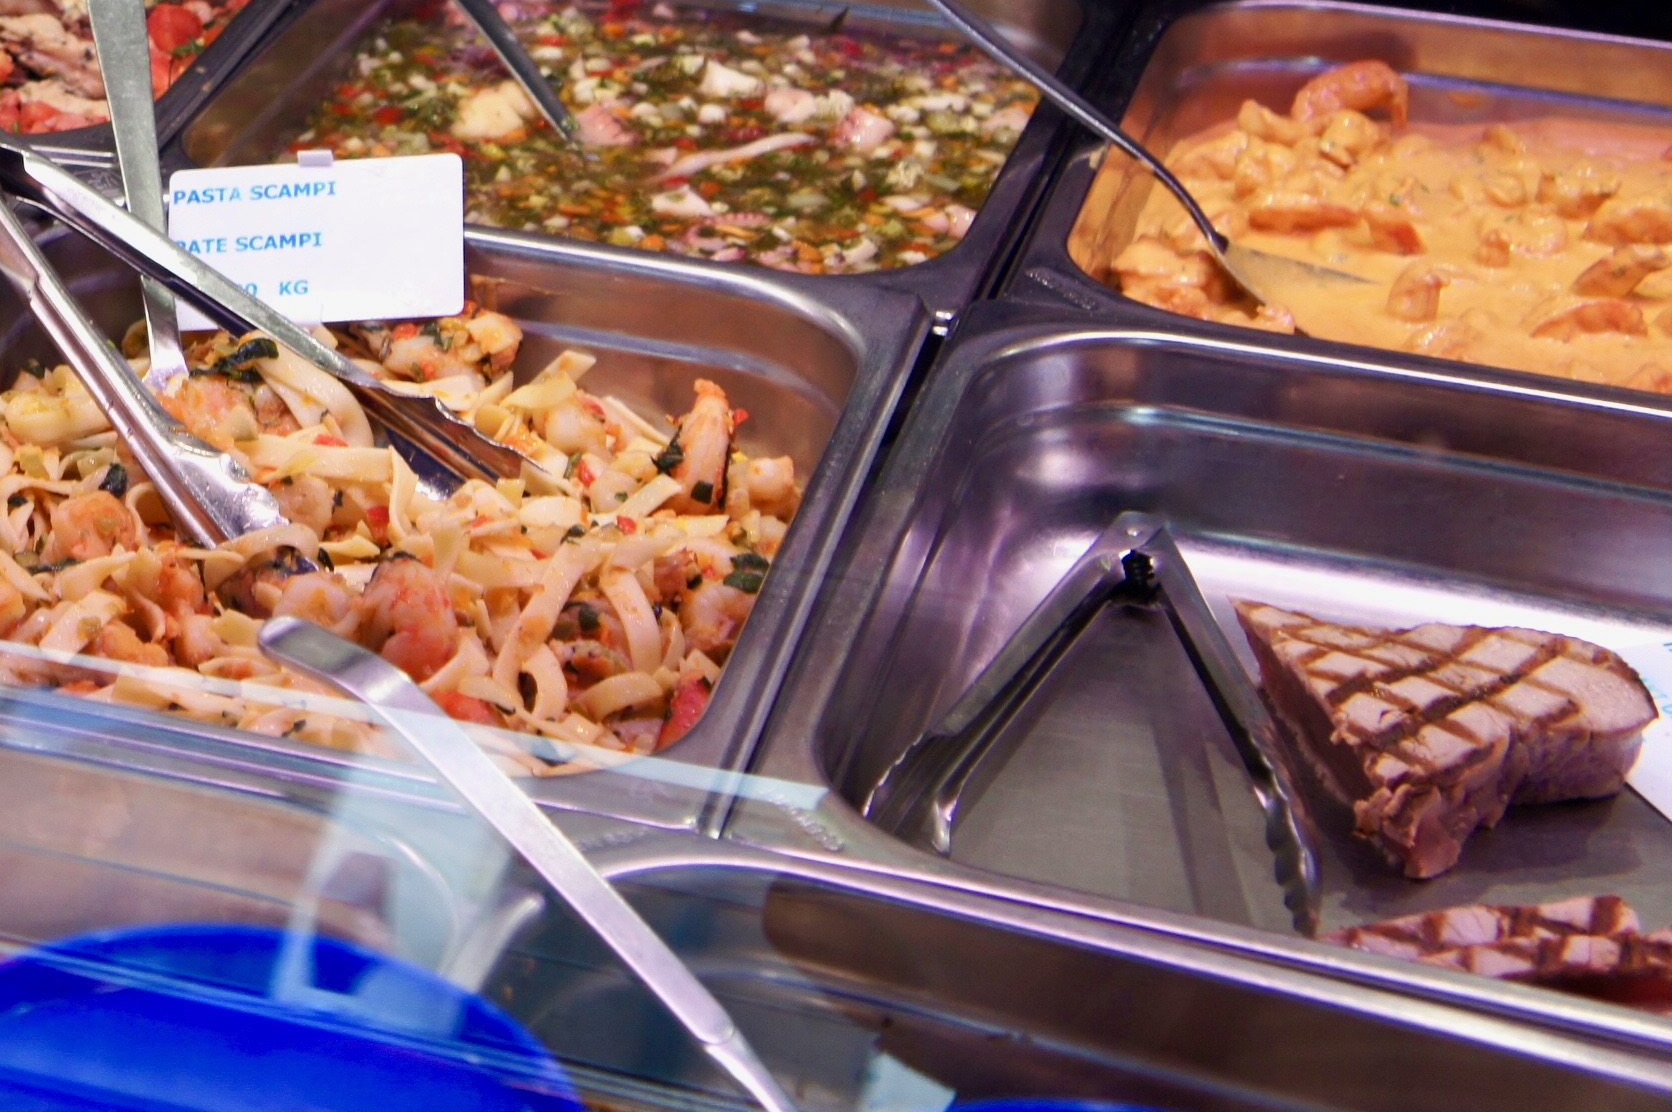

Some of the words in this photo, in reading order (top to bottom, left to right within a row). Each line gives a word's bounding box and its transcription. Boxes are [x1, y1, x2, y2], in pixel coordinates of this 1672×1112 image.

[173, 186, 242, 205] PASTA
[249, 180, 337, 200] SCAMPI
[235, 232, 323, 252] SCAMPI
[278, 279, 309, 296] KG
